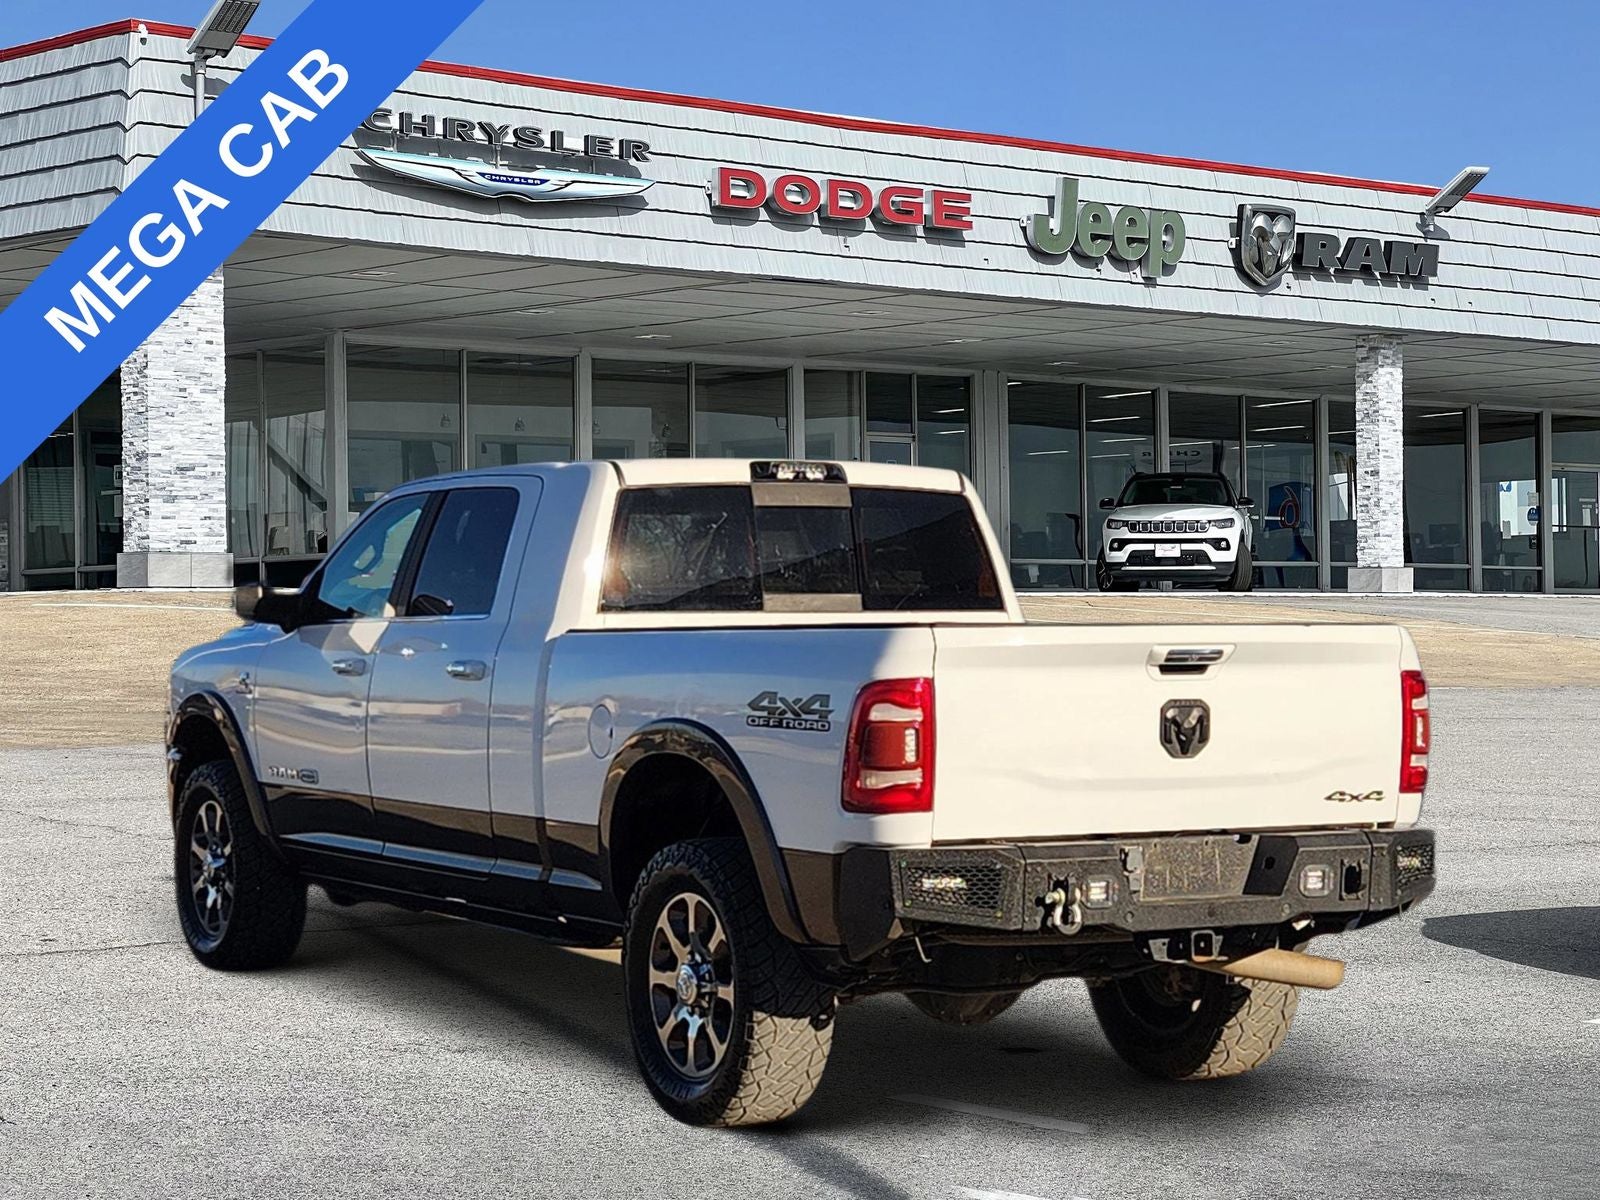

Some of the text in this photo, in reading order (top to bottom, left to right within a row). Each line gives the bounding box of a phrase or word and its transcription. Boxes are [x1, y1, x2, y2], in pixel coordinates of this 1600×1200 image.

[362, 107, 652, 162] CHRYSLER
[484, 174, 541, 185] CHRYSLER
[711, 167, 973, 231] DODGE
[1026, 176, 1186, 279] Jeep
[1295, 232, 1440, 278] RAM
[747, 716, 830, 731] OFF ROAD
